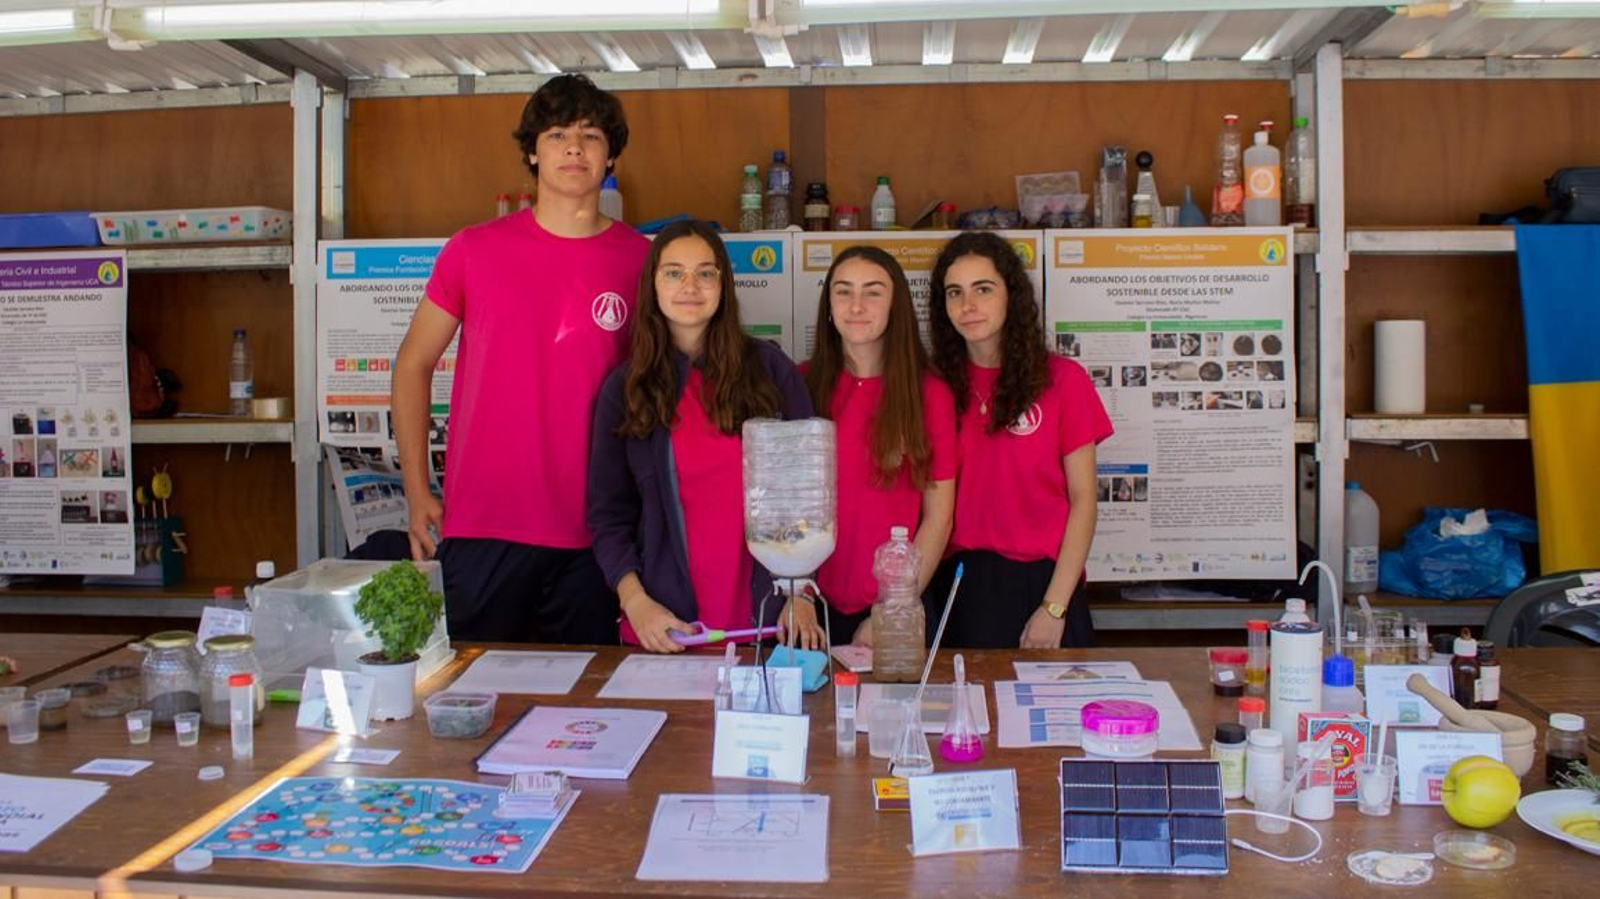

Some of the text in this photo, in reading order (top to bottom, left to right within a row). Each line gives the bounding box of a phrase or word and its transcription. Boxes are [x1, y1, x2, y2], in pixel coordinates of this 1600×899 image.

[1115, 244, 1152, 254] Proyecto
[15, 266, 33, 276] Civil
[41, 265, 77, 274] Industrial
[23, 279, 46, 288] Superior
[86, 277, 99, 286] UCA
[734, 279, 768, 288] RROLLO
[1070, 275, 1270, 284] ABORDANDO LOS OBJETIVOS DE DESARROLLO
[340, 284, 393, 292] ABORDANDO
[395, 284, 411, 292] LOS
[1107, 288, 1234, 296] SOSTENIBLE DESDE LAS STEM
[18, 295, 61, 303] DEMUESTRA
[63, 294, 103, 302] ANDANDO
